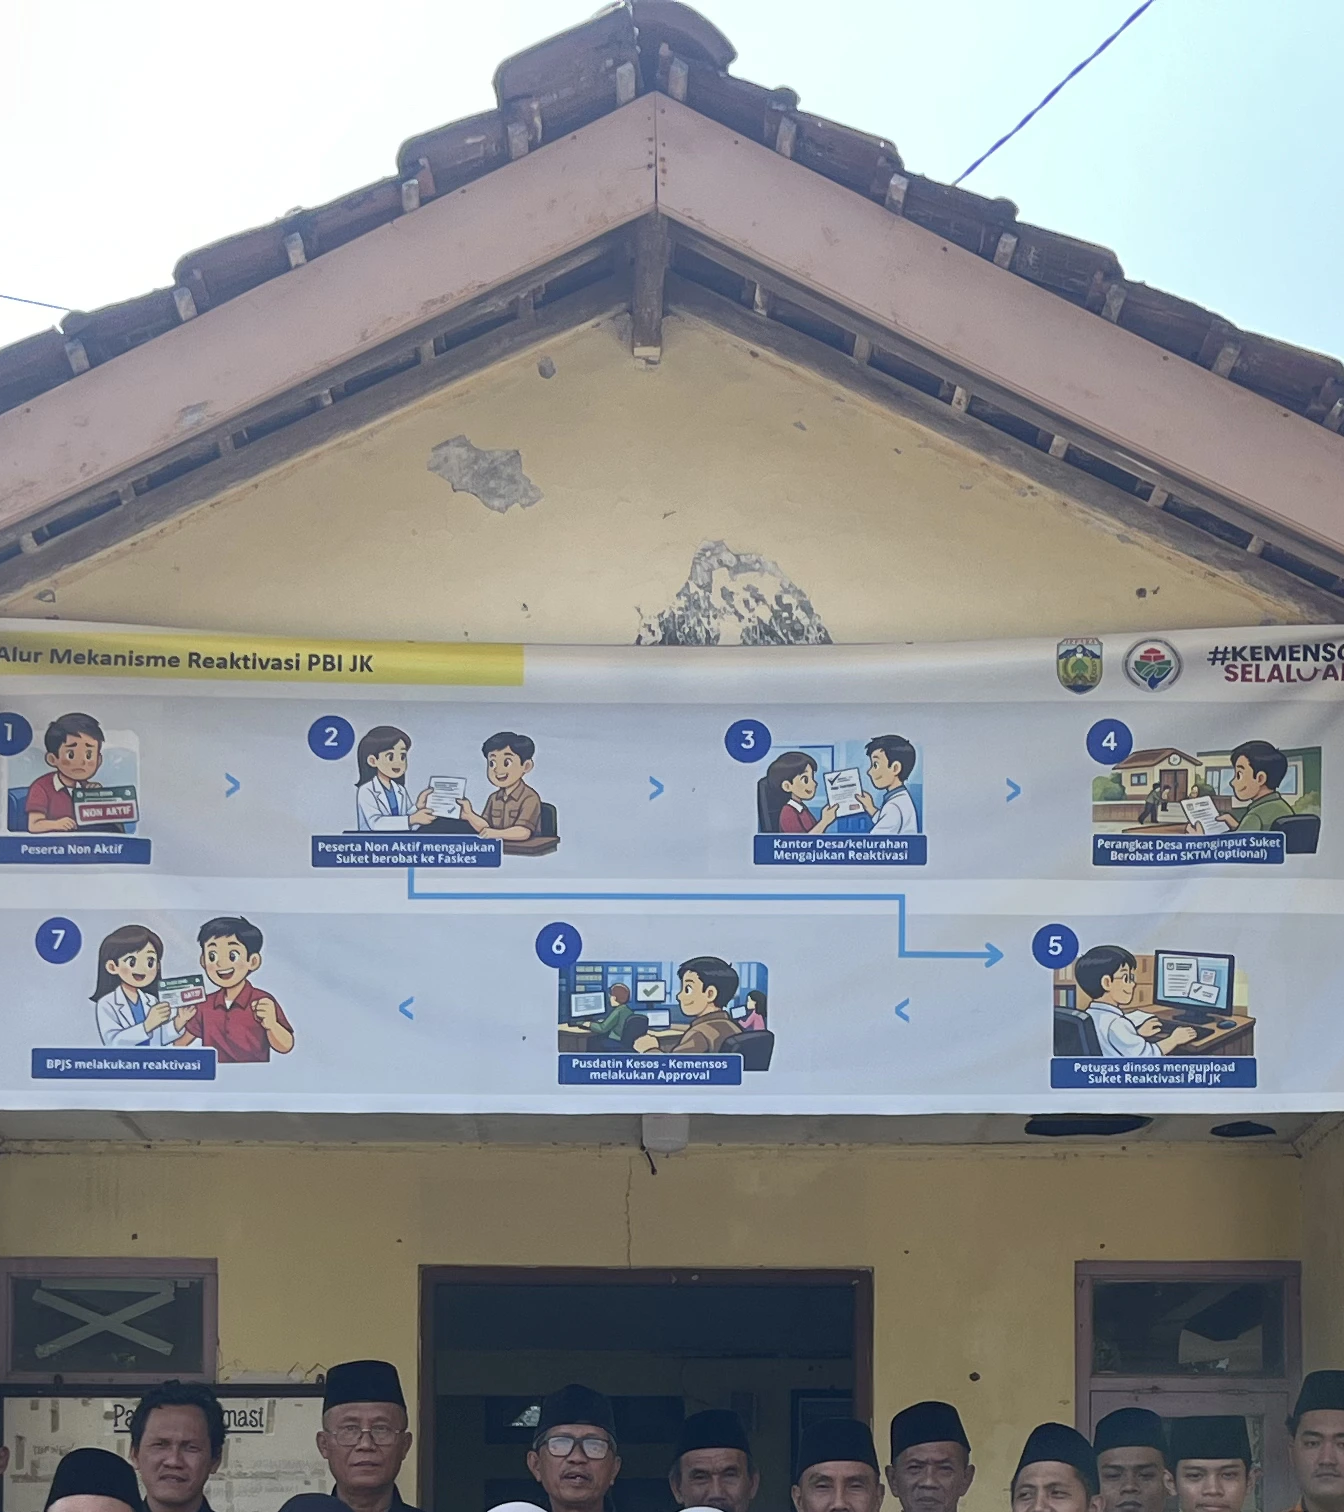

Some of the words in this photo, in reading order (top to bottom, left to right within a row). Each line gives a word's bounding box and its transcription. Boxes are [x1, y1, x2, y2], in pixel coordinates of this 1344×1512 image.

[50, 648, 180, 668] Mekanisme
[188, 652, 301, 671] Reaktivasi
[307, 654, 343, 672] PBI
[348, 655, 374, 674] JK
[4, 722, 13, 742] 1
[324, 727, 338, 747] 2
[741, 730, 755, 749] 3
[1102, 731, 1117, 751] 4
[21, 844, 65, 855] Peserta
[67, 844, 92, 855] Non
[93, 843, 124, 855] Aktif
[318, 841, 362, 852] Peserta
[364, 841, 390, 852] Non
[391, 841, 421, 852] Aktif
[423, 841, 496, 857] mengajukan
[773, 838, 814, 850] Kantor
[816, 838, 909, 850] Desa/kelurahan
[1097, 839, 1154, 852] Perangkat
[1156, 839, 1184, 850] Desa
[1185, 838, 1247, 851] menginput
[1249, 836, 1281, 848] Suket
[336, 853, 370, 864] Suket
[372, 853, 419, 864] berobat
[421, 853, 435, 864] ke
[437, 853, 478, 864] Faskes
[773, 850, 846, 862] Mengajukan
[848, 850, 909, 861] Reaktivasi
[1110, 850, 1154, 861] Berobat
[1156, 850, 1178, 861] dan
[1180, 849, 1211, 861] SKTM
[1213, 848, 1268, 861] (optional)
[51, 929, 66, 950] 7
[551, 934, 566, 955] 6
[1048, 935, 1063, 956] 5
[46, 1059, 72, 1071] BPJS
[74, 1059, 141, 1070] melakukan
[143, 1059, 202, 1071] reaktivasi
[572, 1058, 623, 1069] Pusdatin
[626, 1058, 659, 1069] Kesos
[669, 1058, 728, 1070] Kemensos
[1074, 1062, 1120, 1075] Petugas
[1122, 1062, 1161, 1073] dinsos
[1163, 1061, 1236, 1076] mengupload
[590, 1069, 655, 1081] melakukan
[657, 1069, 711, 1082] Approval
[1088, 1073, 1122, 1085] Suket
[1124, 1073, 1185, 1085] Reaktivasi
[1187, 1073, 1207, 1084] PBI
[1208, 1073, 1222, 1086] JK
